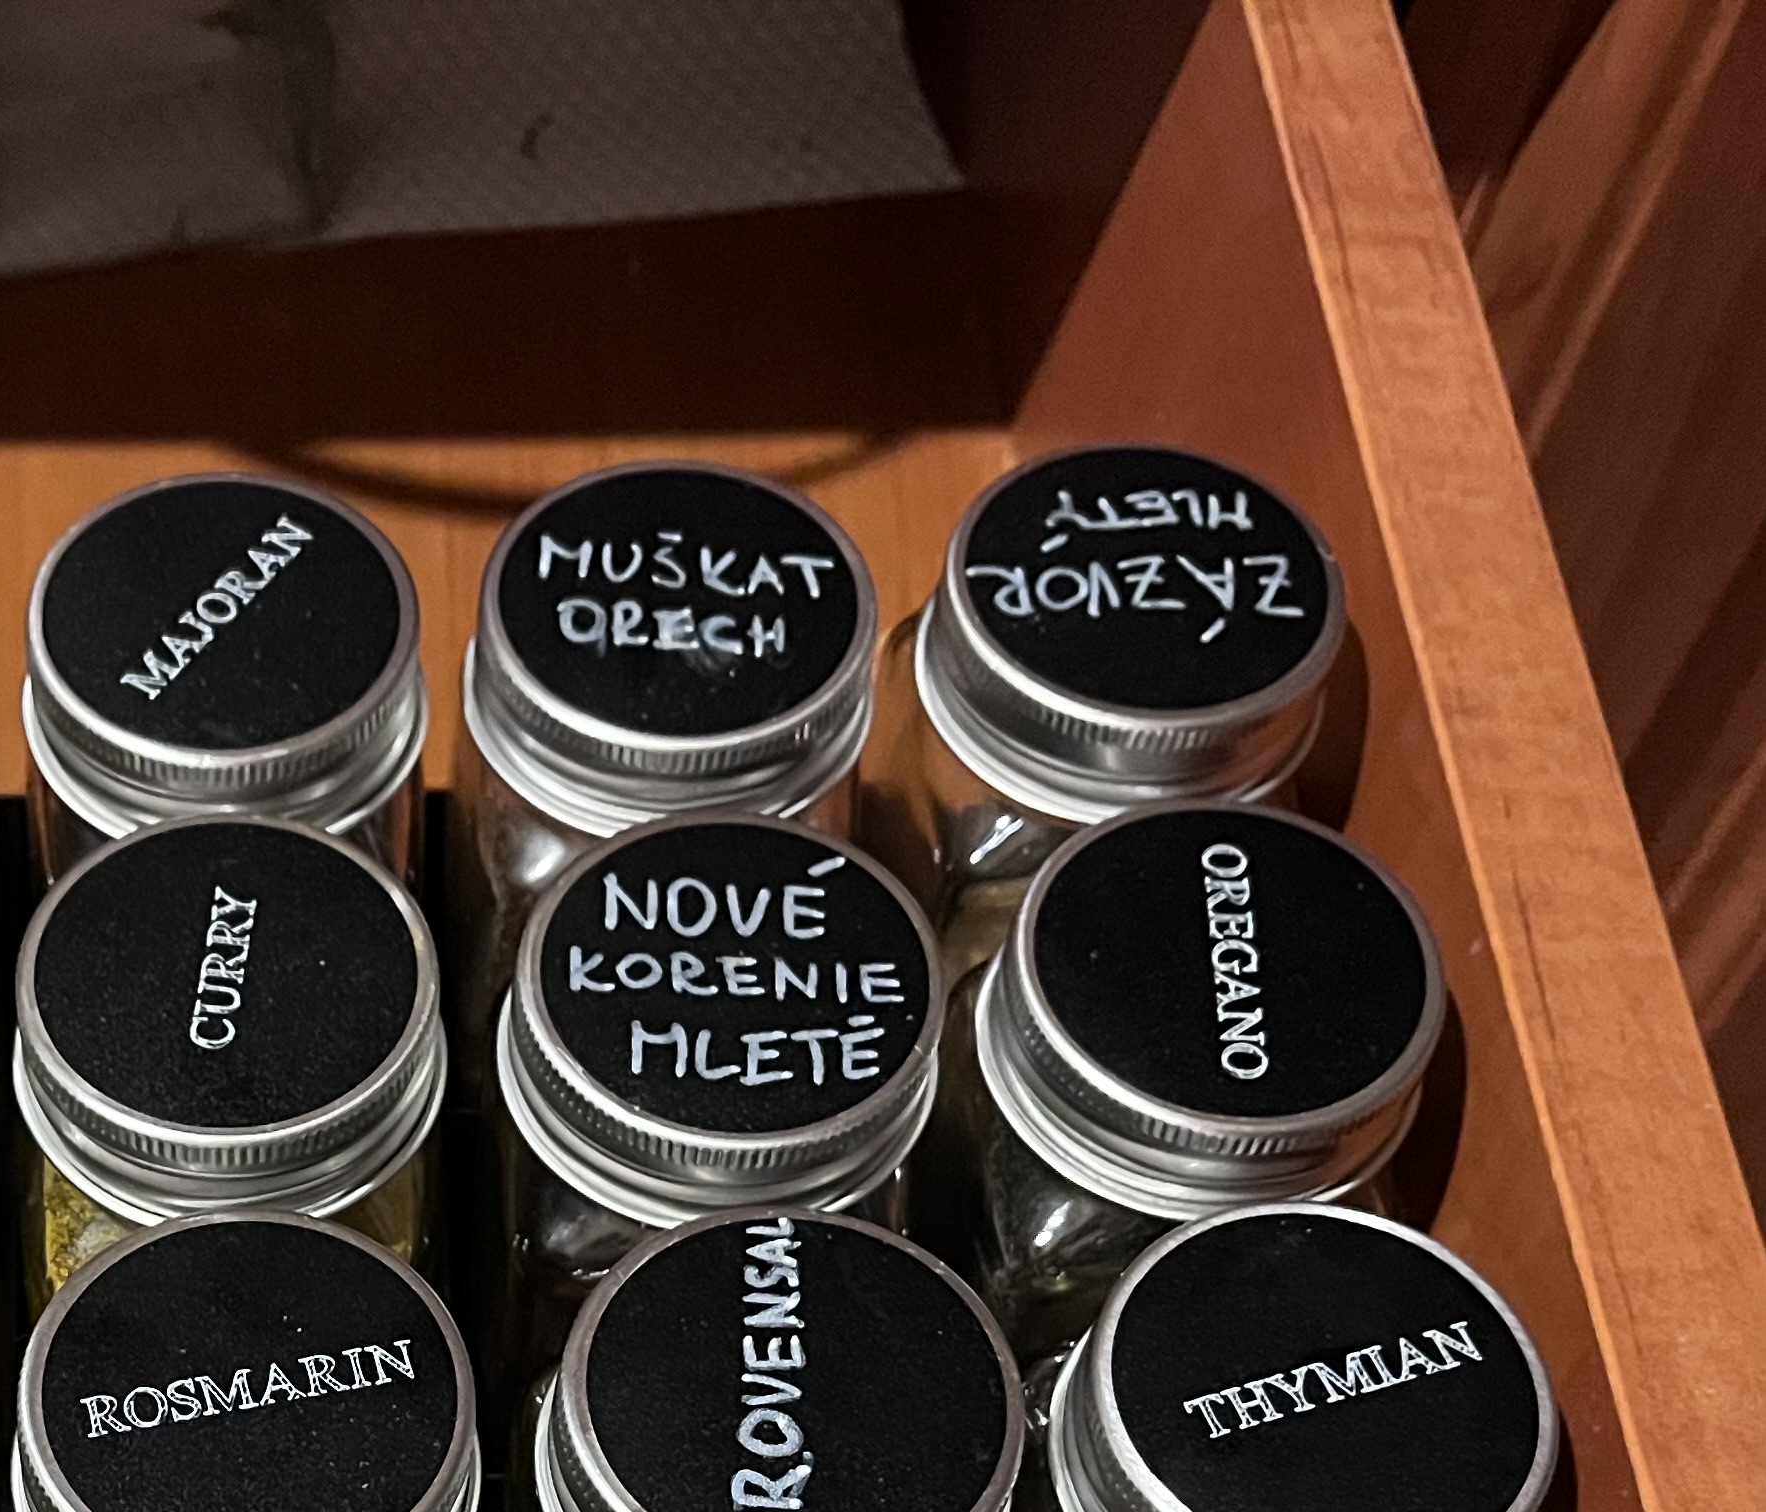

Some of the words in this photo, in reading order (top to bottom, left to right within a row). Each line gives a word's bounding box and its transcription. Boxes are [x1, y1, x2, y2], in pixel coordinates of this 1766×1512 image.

[1041, 489, 1253, 553] MLETÝ
[120, 514, 314, 700] MAJORAN
[538, 531, 834, 599] MUŠKAT
[965, 554, 1304, 643] ZÁZVOR
[557, 597, 785, 657] ORECH
[603, 856, 846, 938] NOVÉ
[189, 886, 258, 1050] CURRY
[568, 945, 905, 1003] KORENIE
[1200, 843, 1270, 1081] OREGANO
[630, 1015, 885, 1086] MLETÉ
[80, 1339, 420, 1439] ROSMARIN
[1183, 1321, 1484, 1439] THYMIAN
